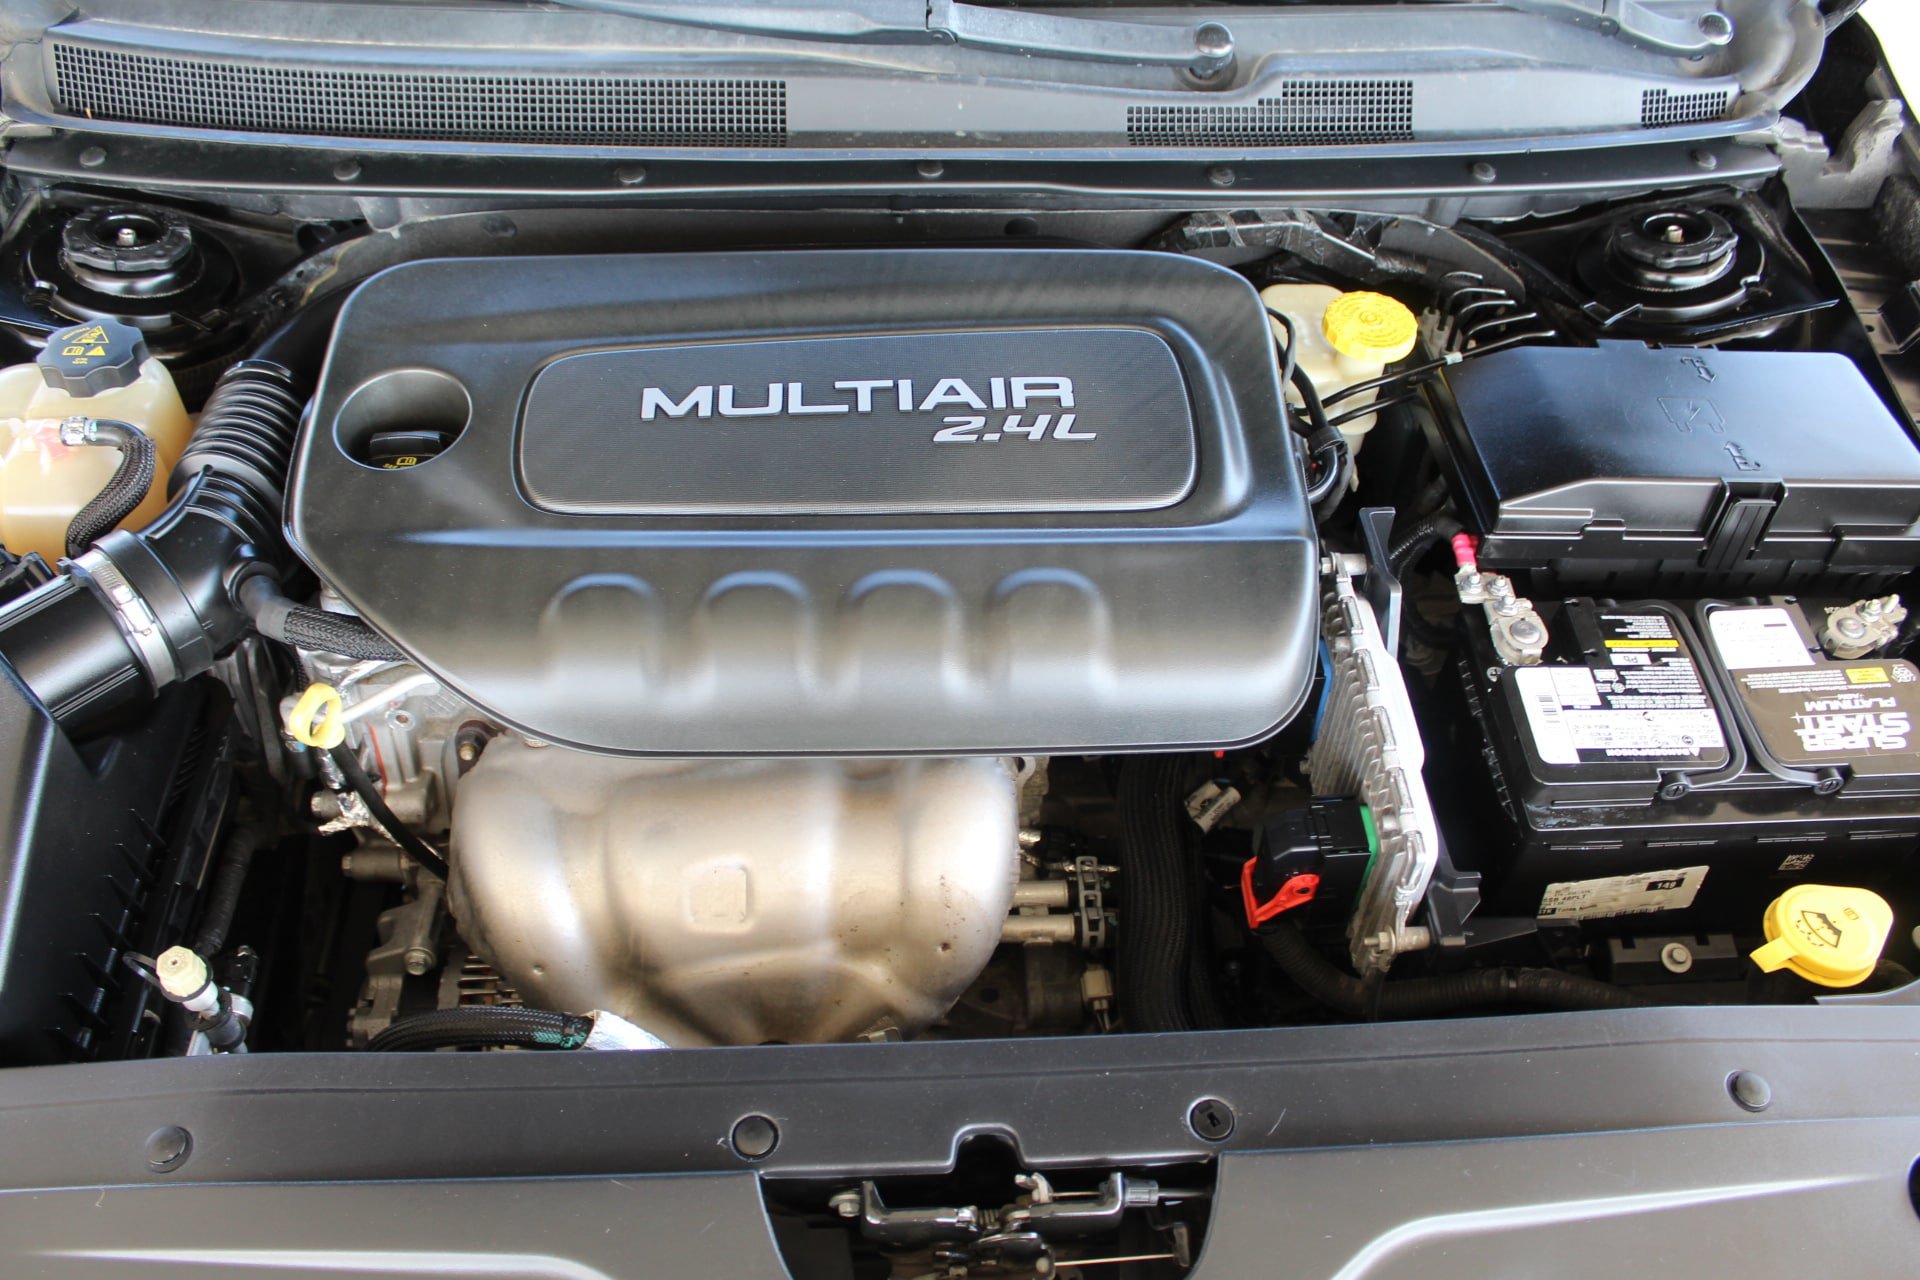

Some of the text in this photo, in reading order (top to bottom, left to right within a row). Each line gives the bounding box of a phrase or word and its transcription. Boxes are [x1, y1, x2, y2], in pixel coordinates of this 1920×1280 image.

[640, 376, 1076, 420] MULTIAIR
[932, 413, 1097, 443] 2.4L
[1804, 697, 1896, 712] PLATINUM
[1795, 712, 1911, 736] START
[1801, 732, 1908, 751] SUPER
[1656, 881, 1676, 889] 149
